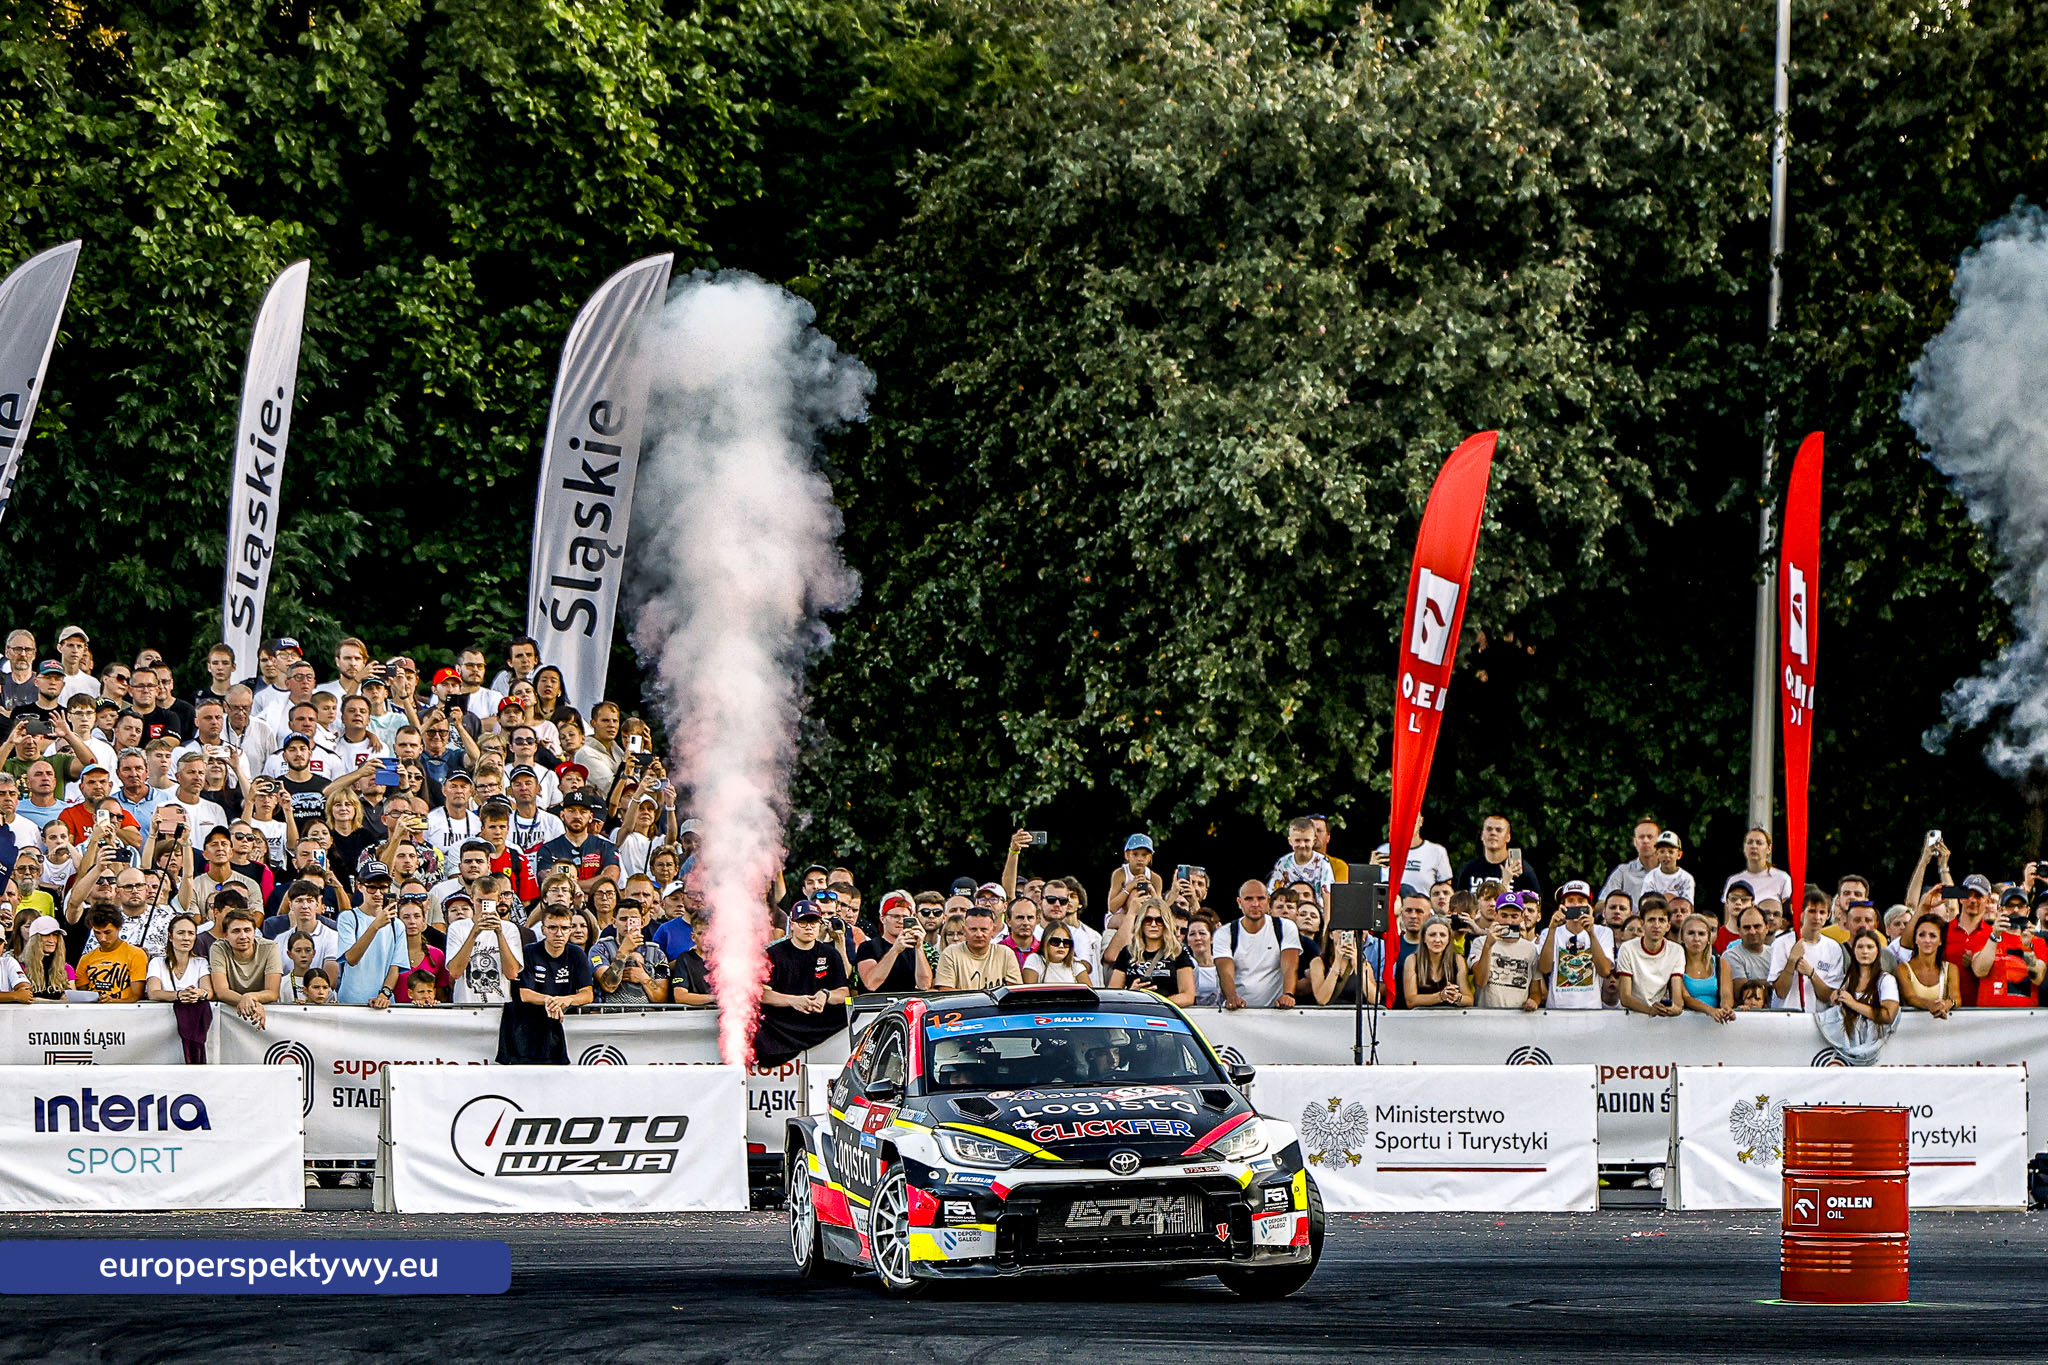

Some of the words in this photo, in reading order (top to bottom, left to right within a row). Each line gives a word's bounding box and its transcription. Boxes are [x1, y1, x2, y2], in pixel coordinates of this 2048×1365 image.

[230, 386, 284, 635] Śląskie.
[927, 1012, 964, 1028] 12
[28, 1031, 80, 1046] STADION
[83, 1028, 126, 1050] ŚLĄSKI
[332, 1087, 381, 1109] STAD
[749, 1089, 797, 1118] LĄSK
[1009, 1098, 1199, 1119] Logista
[1597, 1092, 1655, 1113] ADION
[34, 1087, 212, 1133] interia
[1375, 1104, 1505, 1124] Ministerstwo
[504, 1115, 690, 1146] MOTO
[1031, 1119, 1196, 1143] CLICKFER
[1911, 1125, 1977, 1149] rystyki
[1375, 1131, 1441, 1153] Sportu
[1447, 1131, 1452, 1150] i
[1458, 1131, 1548, 1154] Turystyki
[67, 1147, 183, 1174] SPORT
[500, 1152, 673, 1174] WIZJA
[958, 1175, 994, 1184] MICHELIN
[1826, 1196, 1873, 1209] ORLEN
[1268, 1216, 1287, 1225] DEPORTE
[1826, 1210, 1845, 1219] OIL
